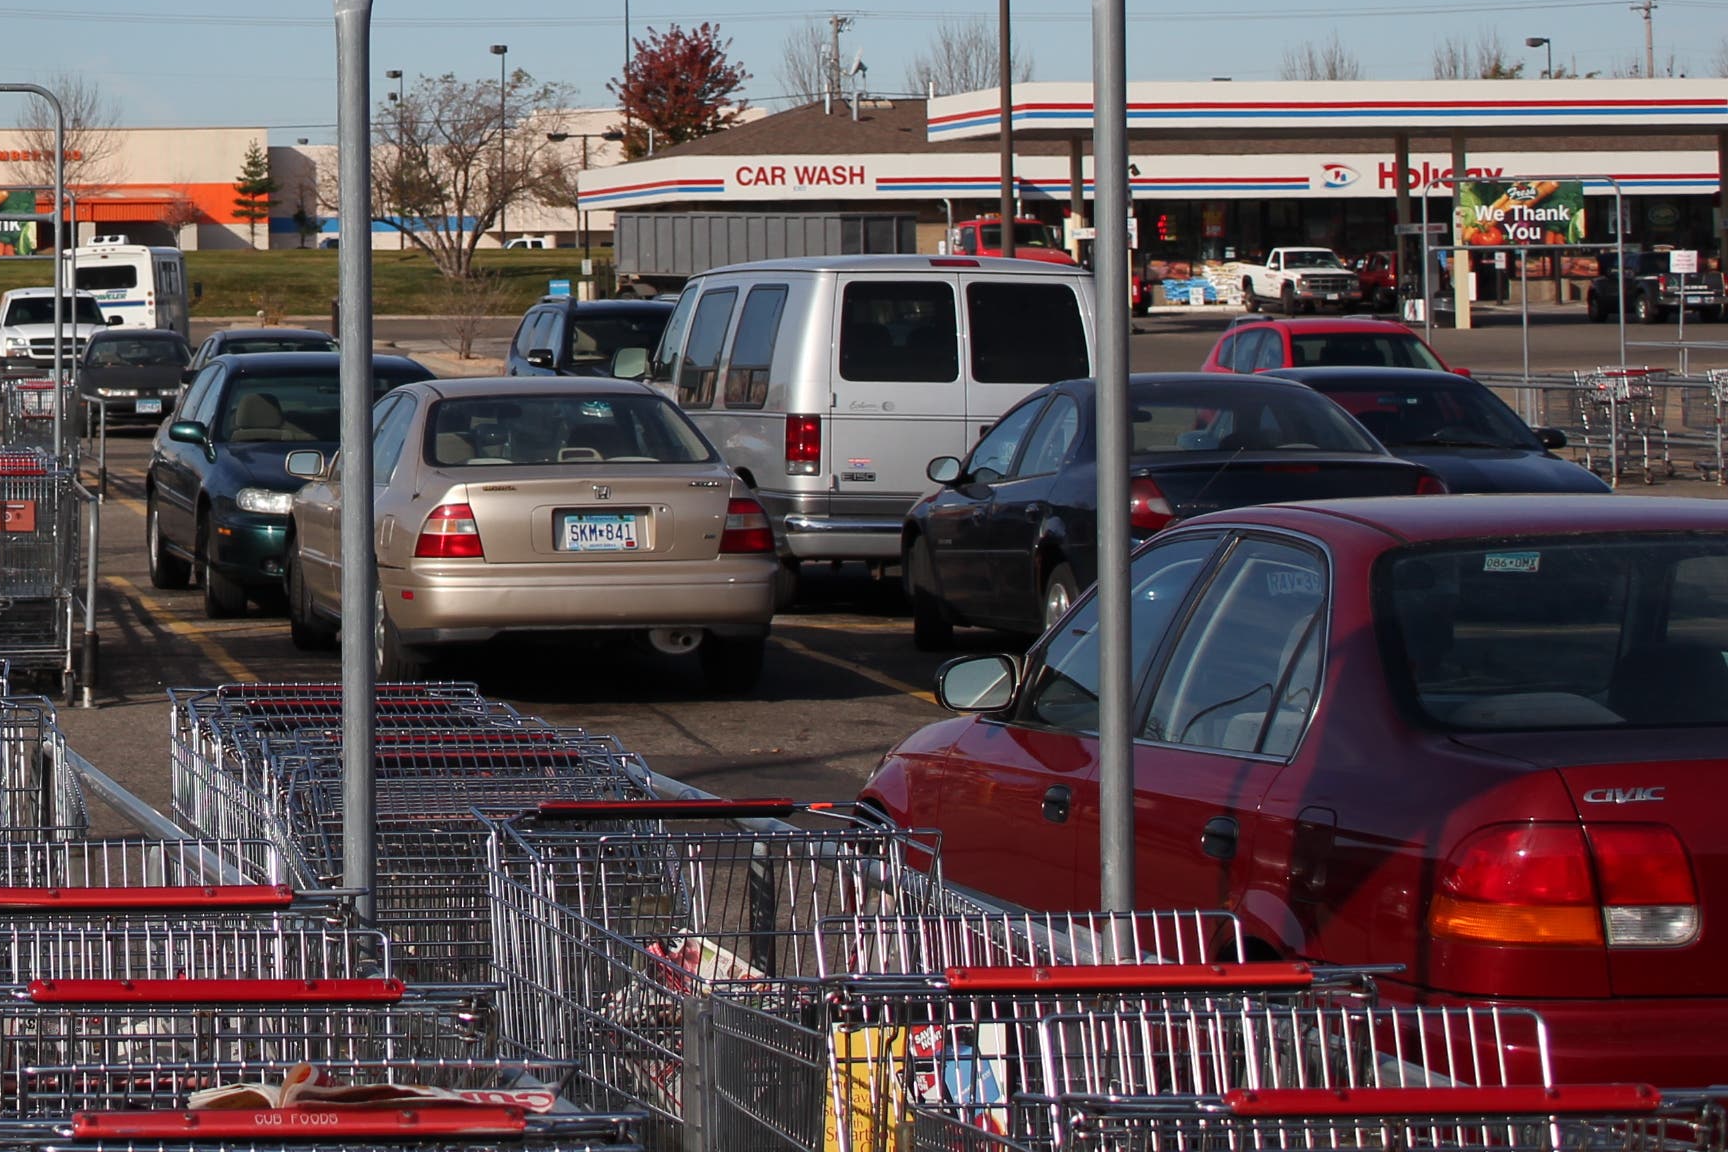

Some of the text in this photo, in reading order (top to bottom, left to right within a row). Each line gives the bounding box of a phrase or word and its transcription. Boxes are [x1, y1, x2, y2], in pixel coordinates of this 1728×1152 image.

[735, 165, 865, 186] CAR WASH
[1506, 186, 1538, 200] Fresh
[1474, 205, 1571, 221] We Thank
[1503, 223, 1542, 240] You
[1582, 786, 1666, 804] CIVIC
[254, 1112, 339, 1126] CUB FOODS
